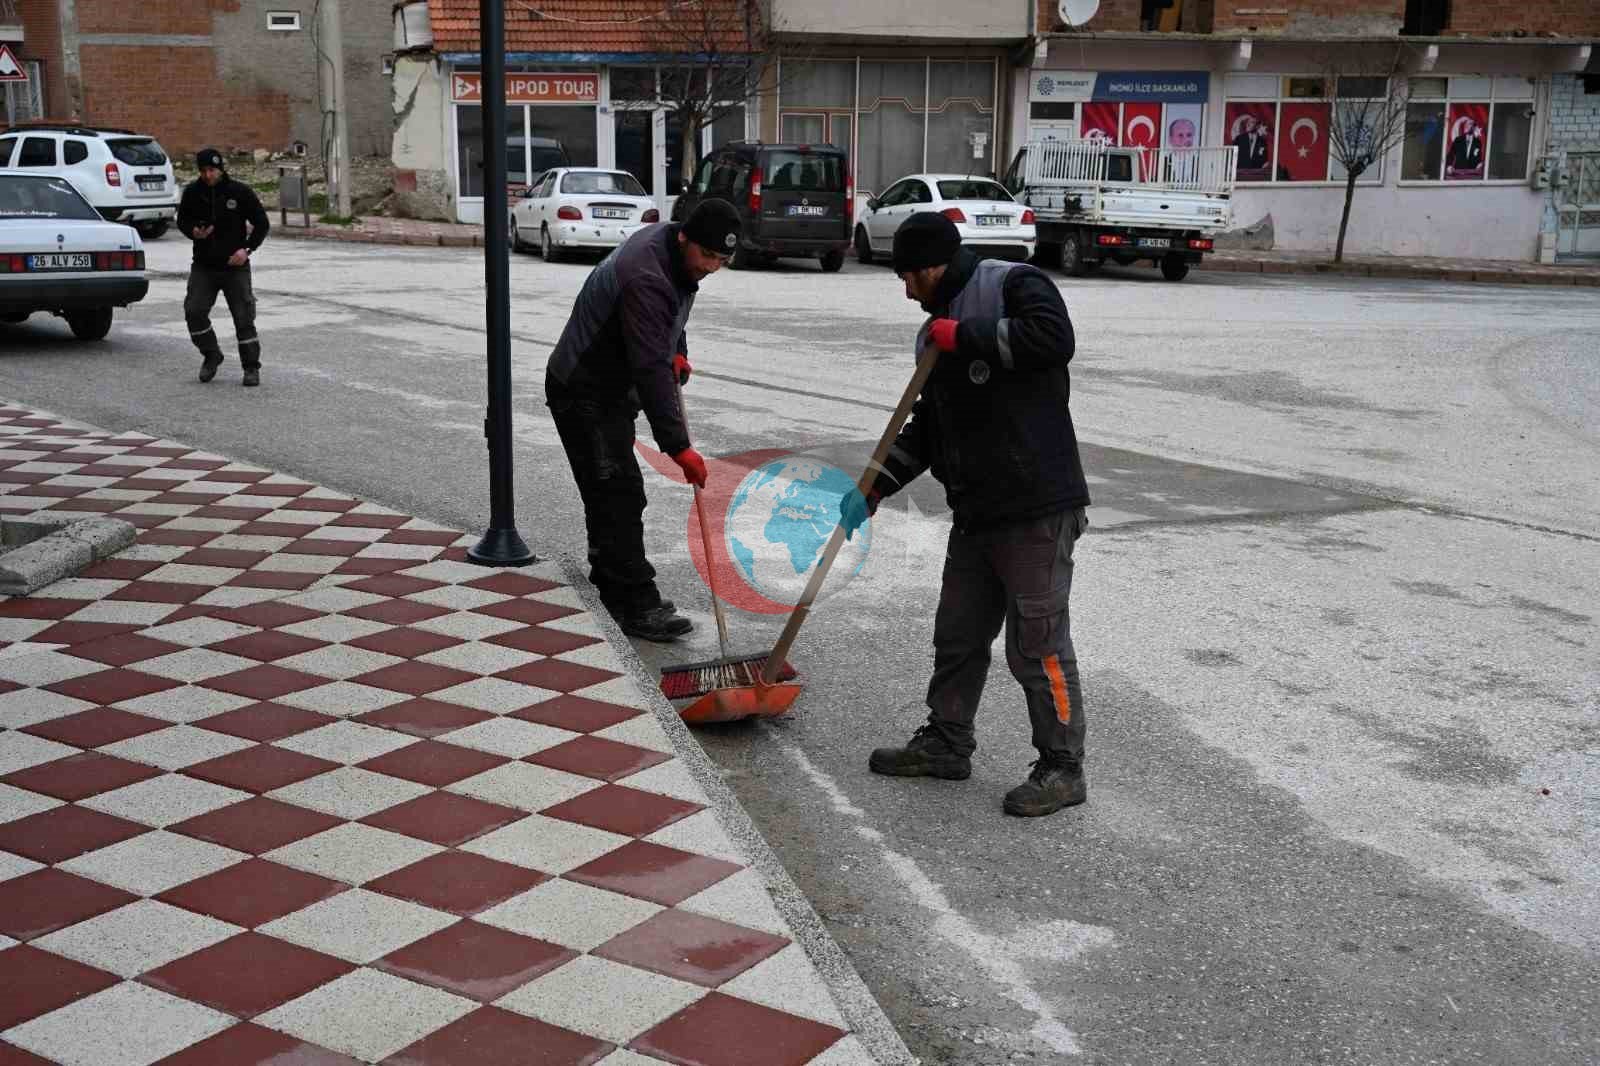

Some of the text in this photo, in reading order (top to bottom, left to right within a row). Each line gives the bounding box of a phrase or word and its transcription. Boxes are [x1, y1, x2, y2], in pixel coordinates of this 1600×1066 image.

[553, 80, 595, 96] TOUR
[34, 255, 46, 266] 26
[51, 255, 69, 266] ALV
